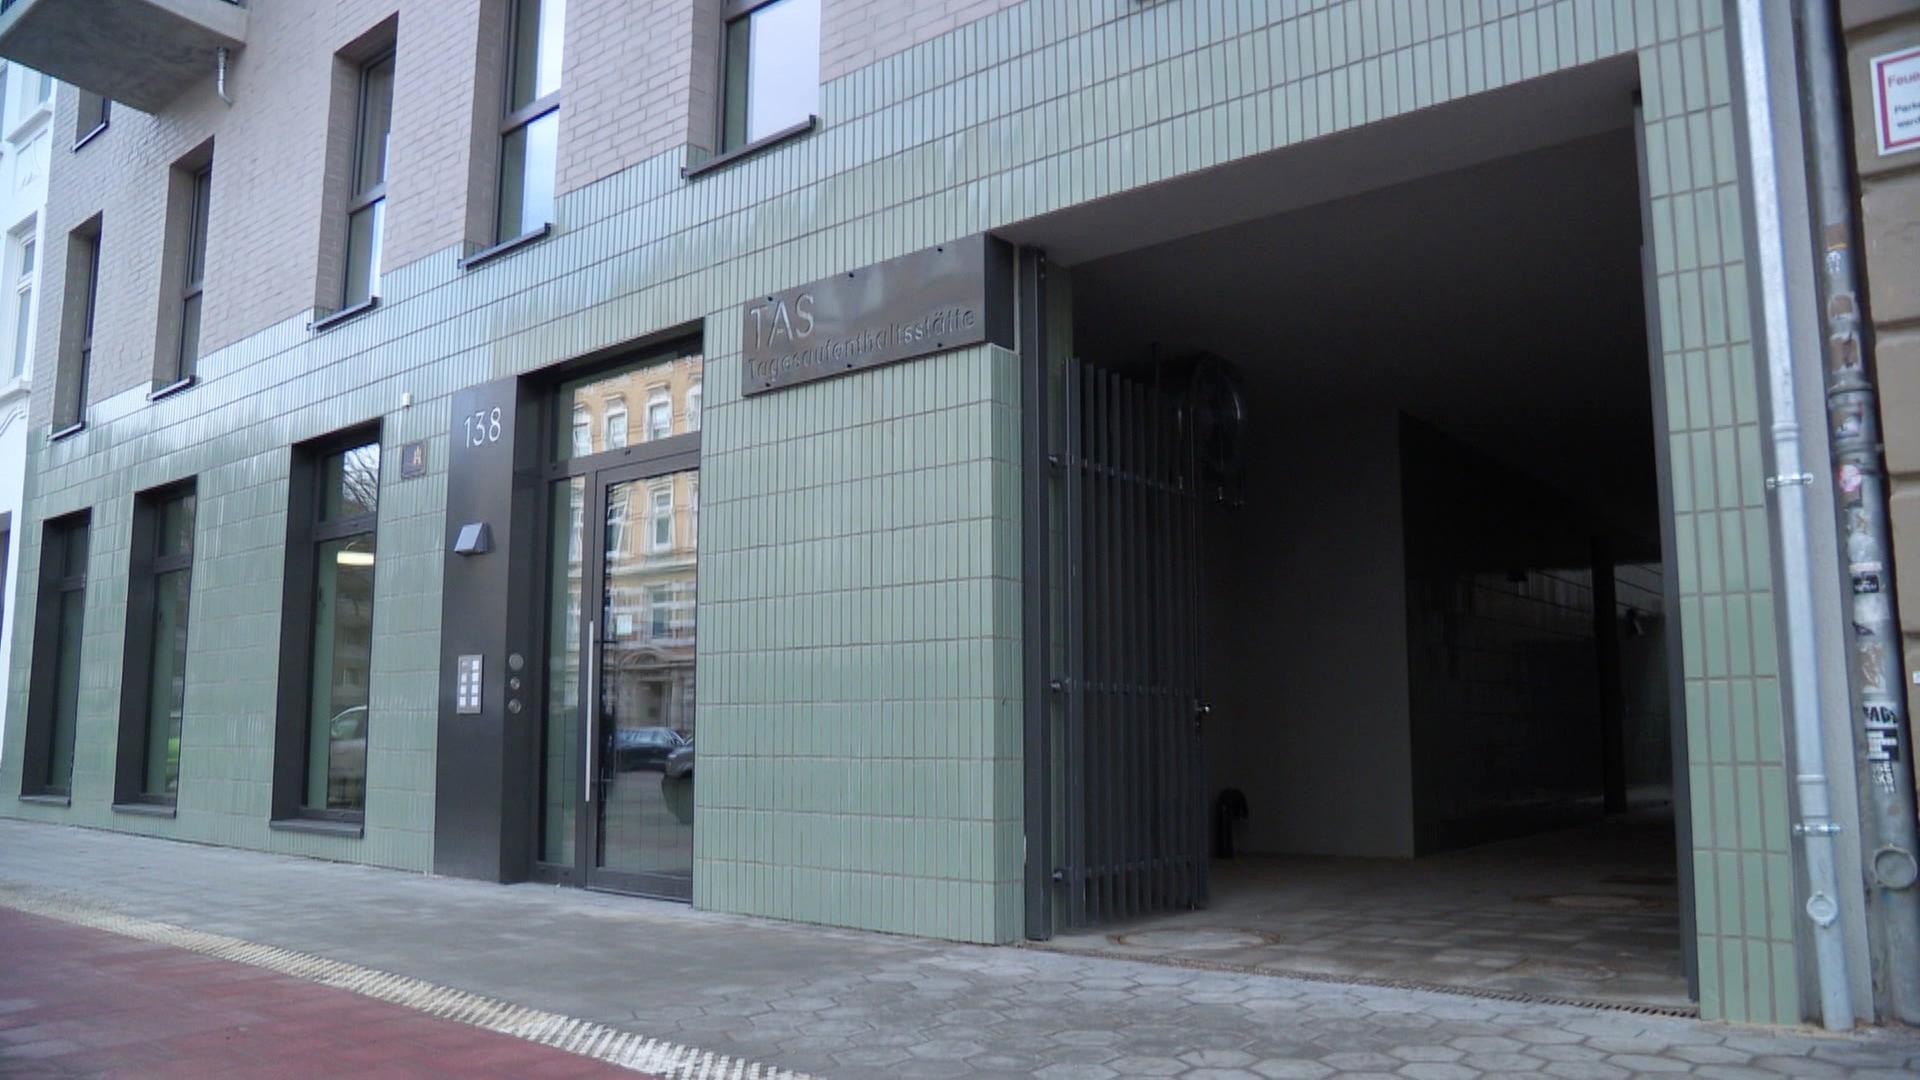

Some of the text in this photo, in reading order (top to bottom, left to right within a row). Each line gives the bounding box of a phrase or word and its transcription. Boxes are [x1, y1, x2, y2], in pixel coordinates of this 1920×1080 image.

[748, 308, 976, 382] Tagesaufenthaltsstätte
[750, 292, 814, 350] TAS
[463, 406, 501, 449] 138
